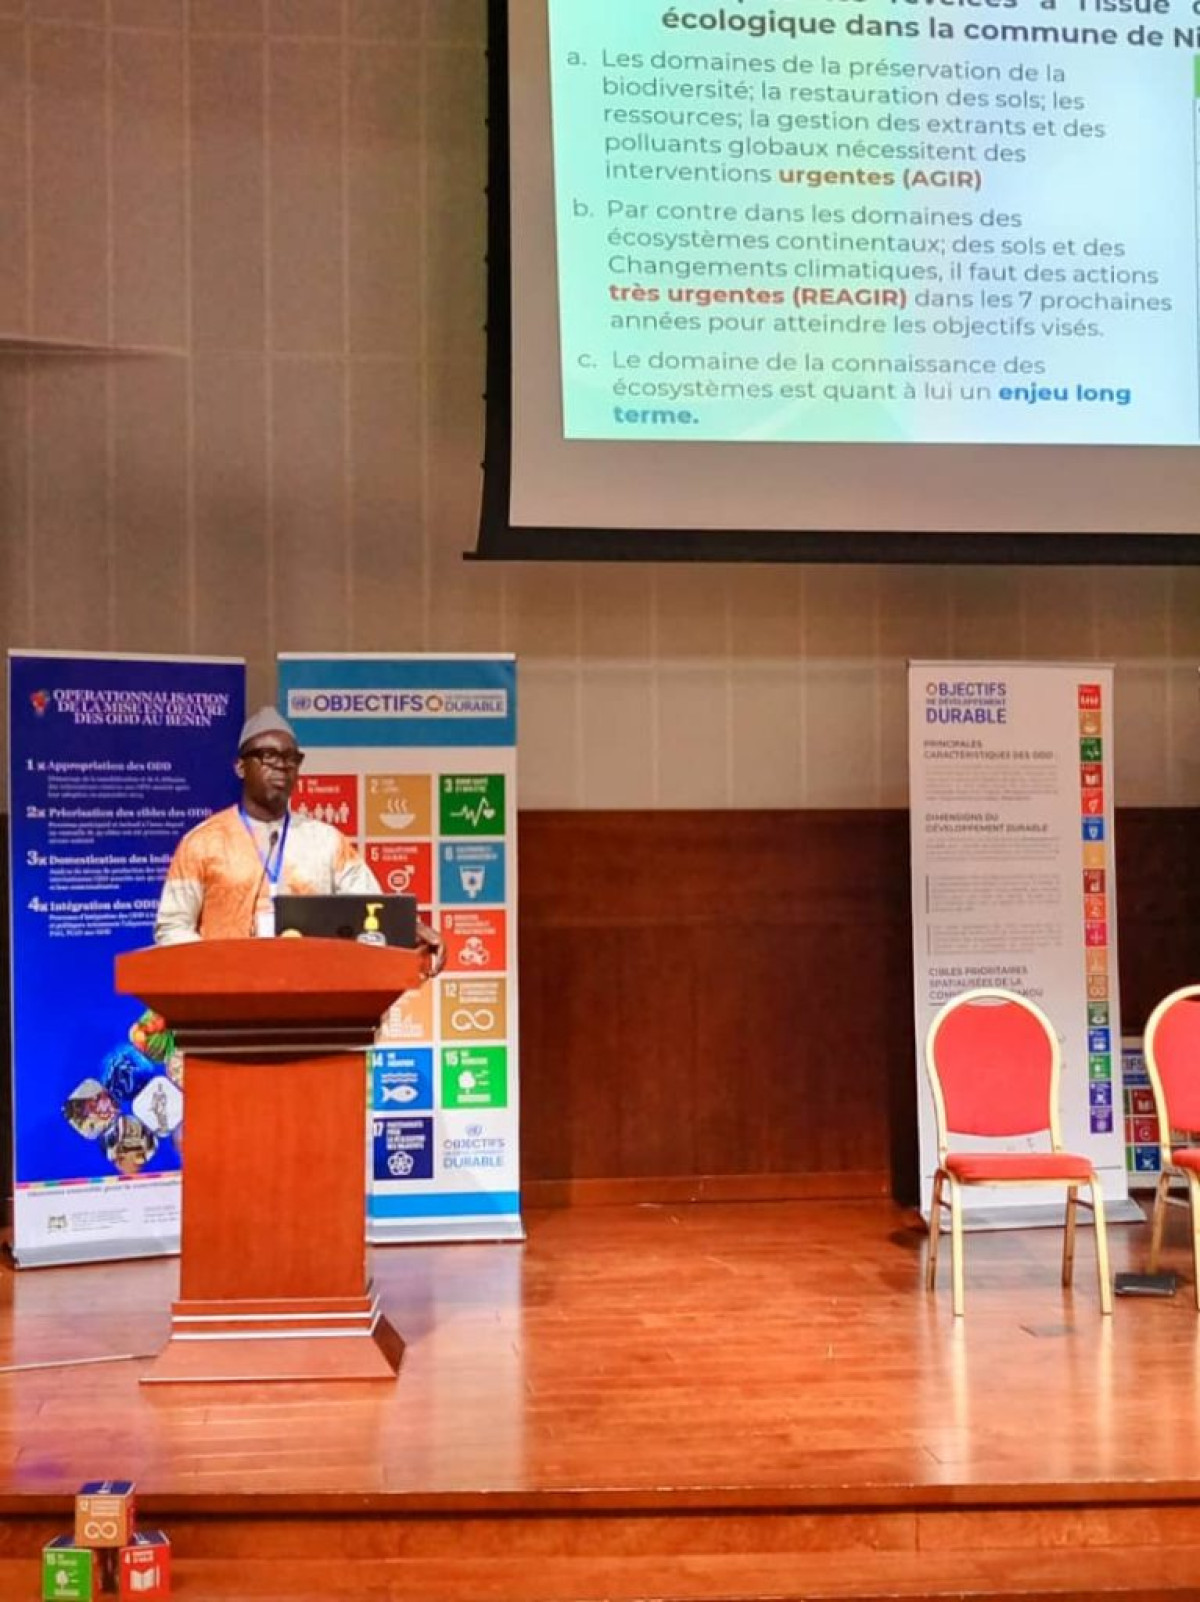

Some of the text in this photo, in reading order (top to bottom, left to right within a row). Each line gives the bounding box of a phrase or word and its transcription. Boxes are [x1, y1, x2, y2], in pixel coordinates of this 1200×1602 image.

[661, 5, 837, 39] écologique
[845, 12, 920, 37] dans
[929, 15, 955, 38] la
[963, 21, 1118, 44] commune
[1126, 22, 1164, 46] de
[567, 48, 1065, 85] a. Les domaines de la préservation de la
[603, 76, 1084, 112] biodiversité; la restauration des sols; les
[604, 108, 1106, 138] ressources; la gestion des extrants et des
[605, 132, 1026, 162] polluants globaux nécessitent des
[607, 160, 981, 193] interventions urgentes (AGIR)
[573, 198, 1022, 228] b. Par contre dans les domaines des
[607, 228, 1125, 257] écosystèmes continentaux; des sols et des
[608, 256, 1158, 285] Changements climatiques, il faut des actions
[610, 283, 1172, 317] très urgentes (REAGIR) dans les 7 prochaines
[611, 311, 1103, 341] années pour atteindre les objectifs visés.
[578, 350, 1046, 374] c. Le domaine de la connaissance des
[613, 379, 1132, 407] écosystèmes est quant à lui un enjeu long
[611, 406, 702, 424] terme.
[53, 689, 228, 705] OPERATIONNALISATION
[314, 695, 422, 712] OBJECTIFS
[926, 682, 1006, 696] OBJECTIFS
[445, 701, 503, 712] DURABLE
[926, 708, 1006, 724] DURABLE
